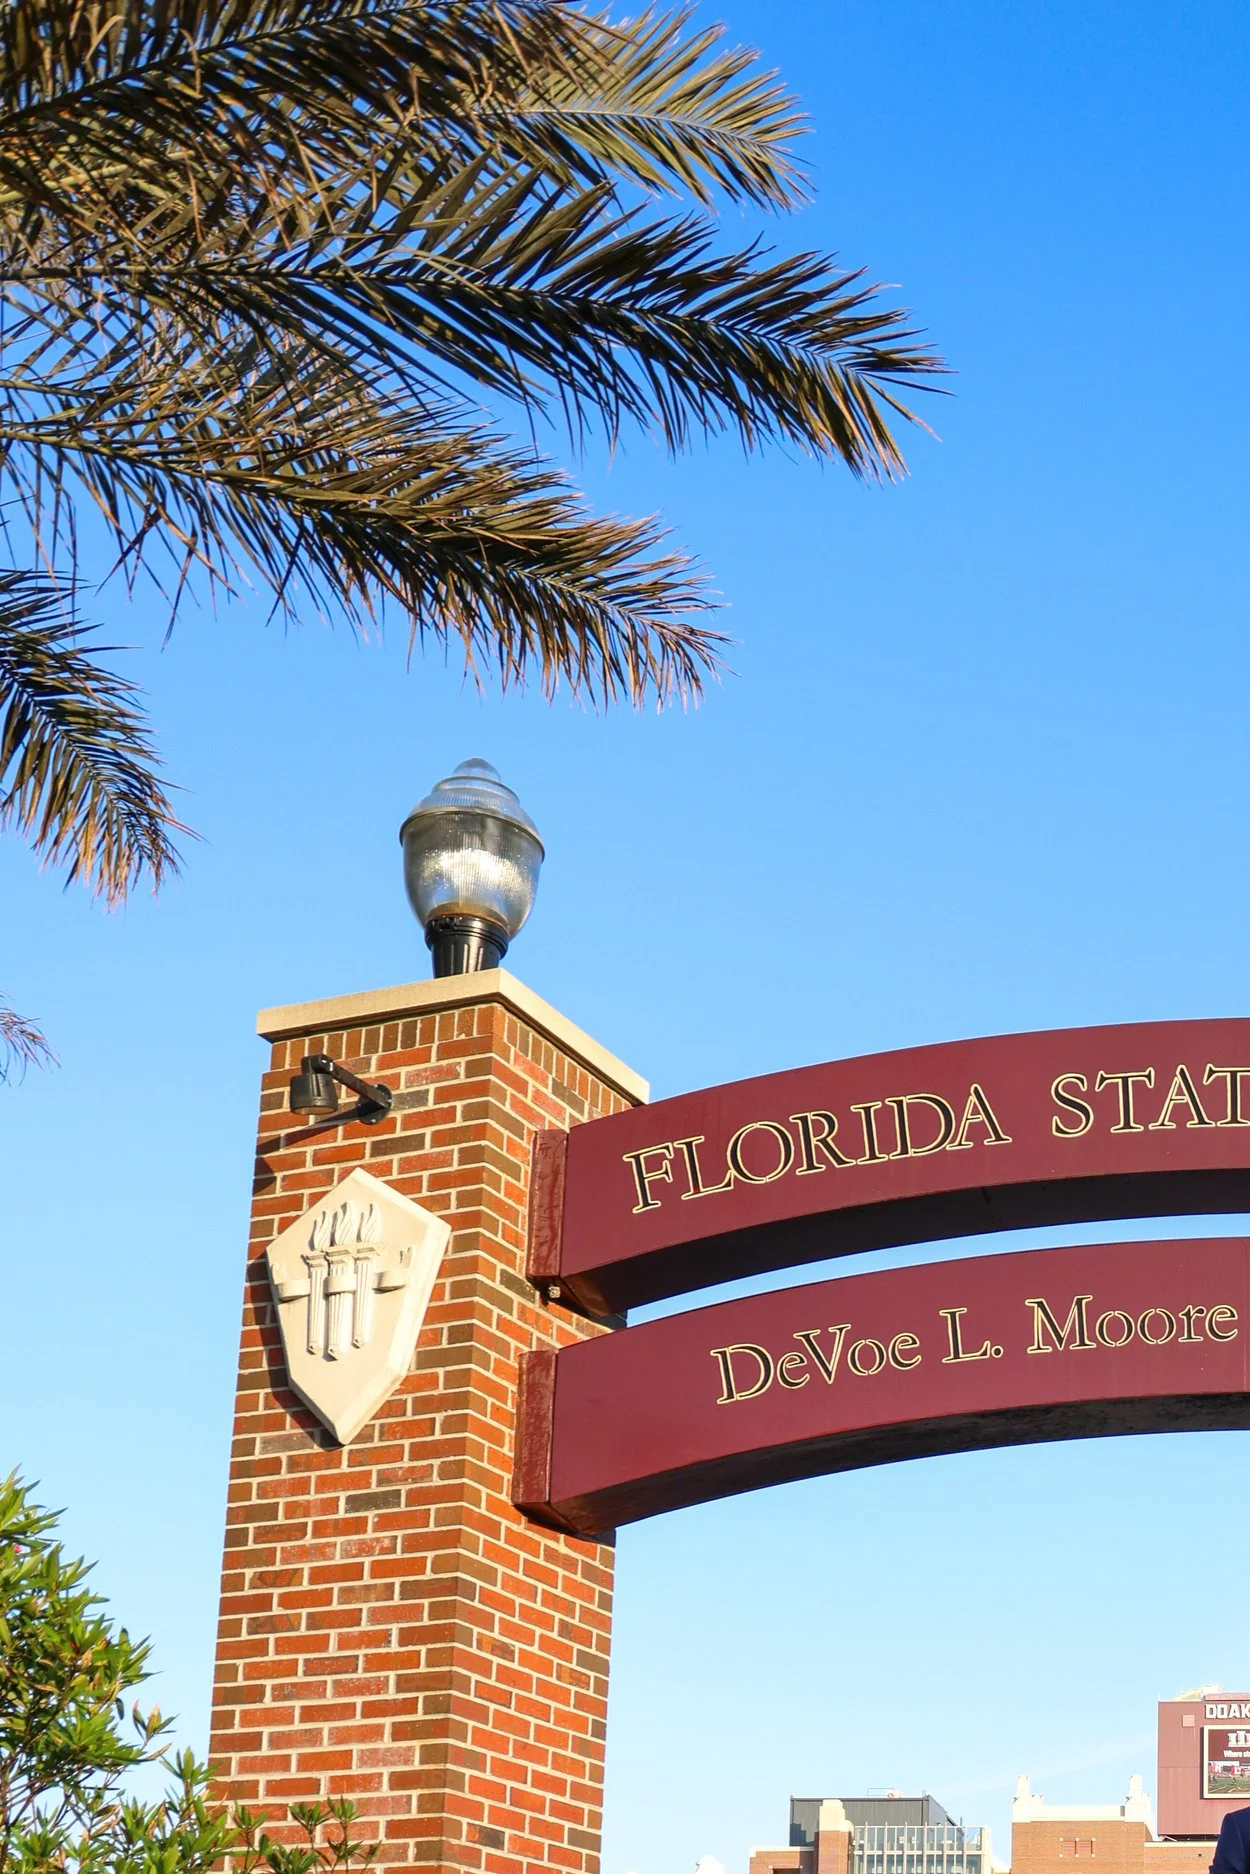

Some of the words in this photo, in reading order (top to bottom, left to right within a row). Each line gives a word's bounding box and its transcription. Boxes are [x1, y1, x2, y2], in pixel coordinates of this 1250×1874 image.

[622, 1083, 1012, 1214] FLORIDA
[710, 1321, 923, 1405] DeVoe
[940, 1306, 1004, 1364] L.
[1024, 1294, 1239, 1355] Moore
[1223, 1750, 1243, 1758] Where
